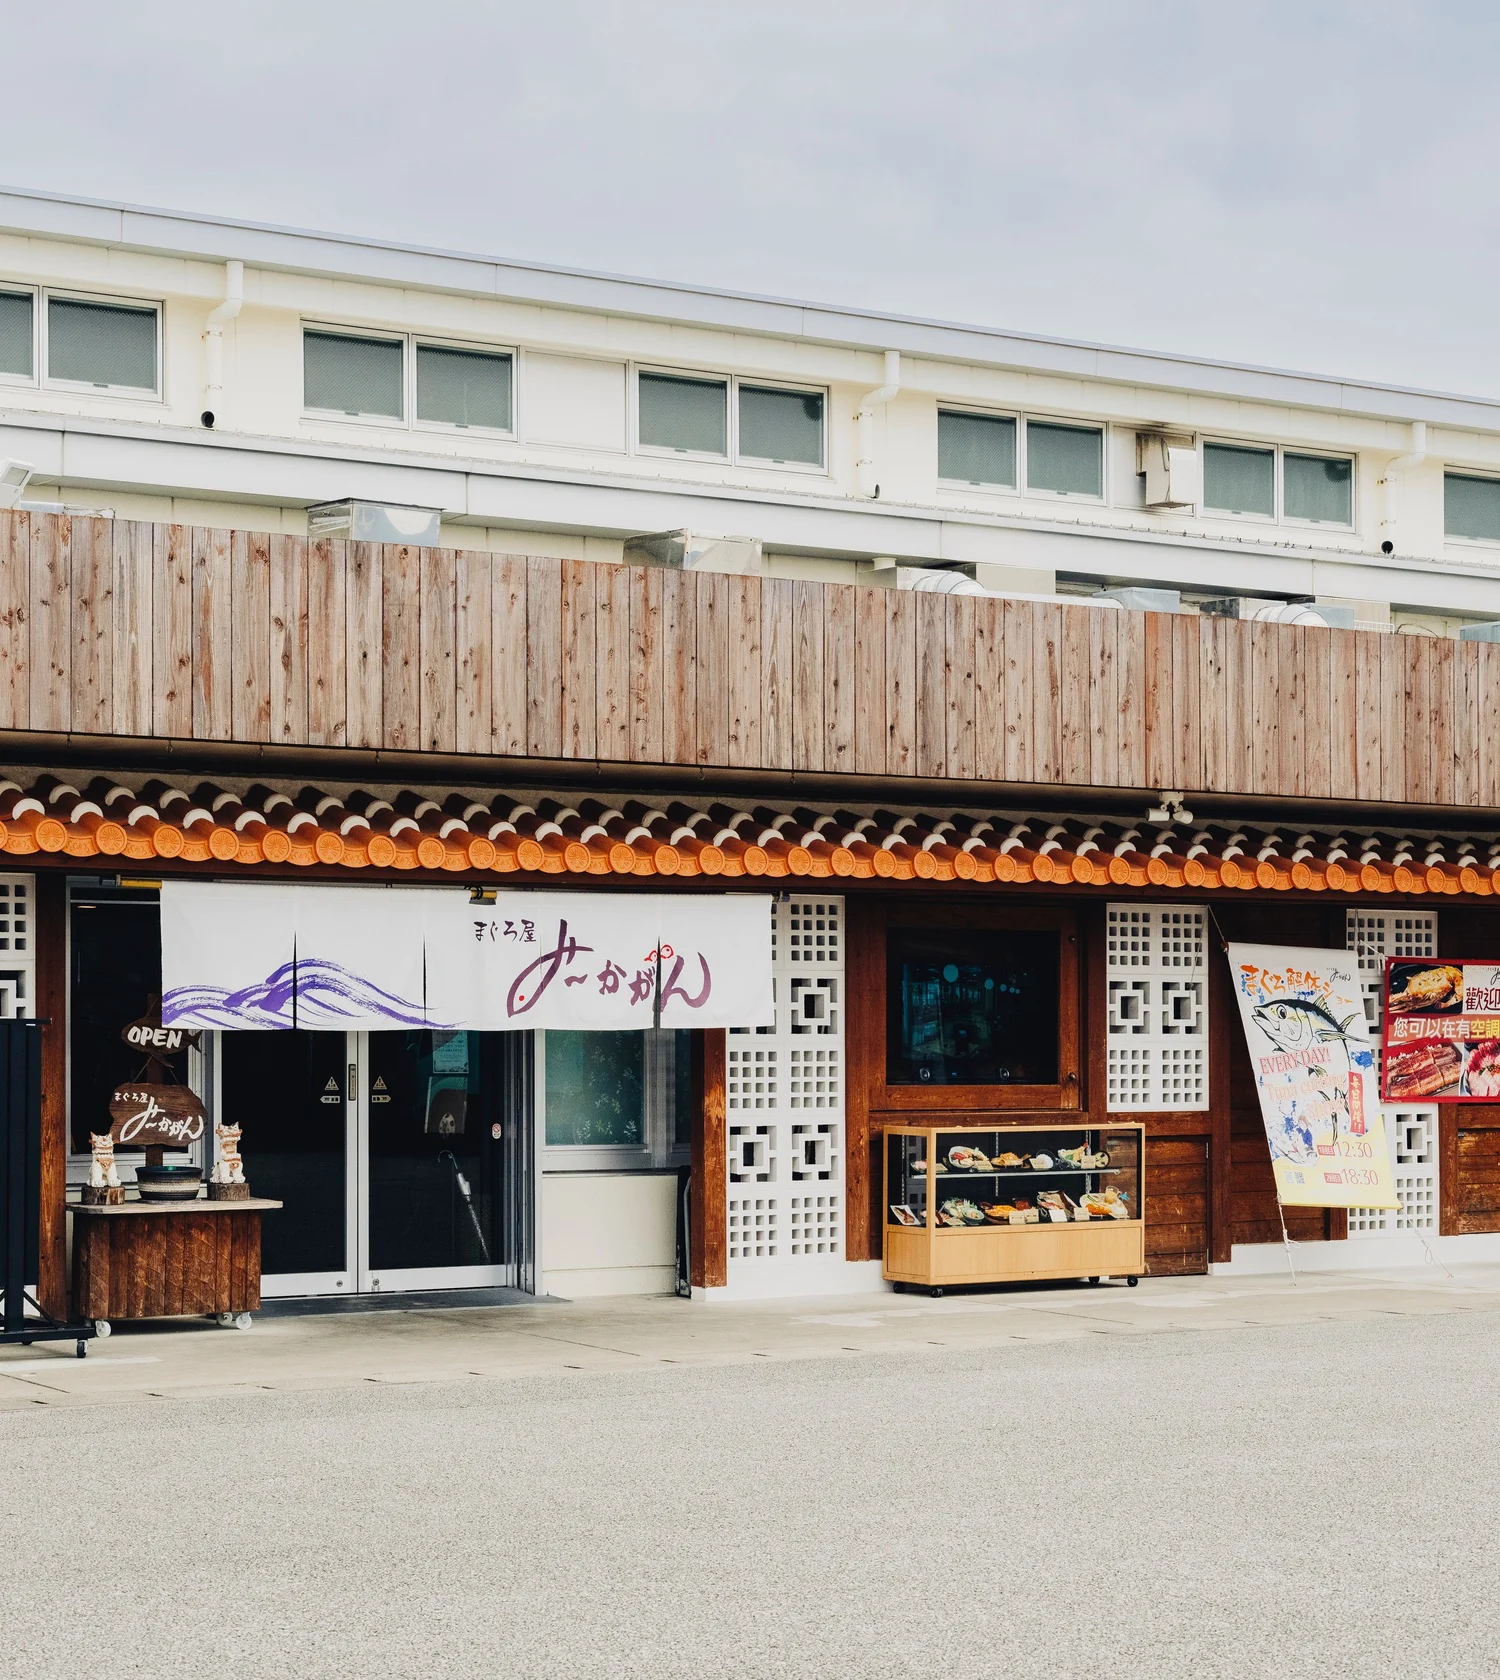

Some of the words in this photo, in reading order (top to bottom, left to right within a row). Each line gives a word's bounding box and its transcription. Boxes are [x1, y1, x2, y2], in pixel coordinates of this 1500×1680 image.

[473, 919, 537, 943] まぐろ屋
[127, 1026, 182, 1048] OPEN
[114, 1092, 149, 1103] まぐろ屋
[1264, 1083, 1297, 1099] Tuna
[1335, 1141, 1373, 1158] 12:30
[1341, 1168, 1379, 1186] 18:30
